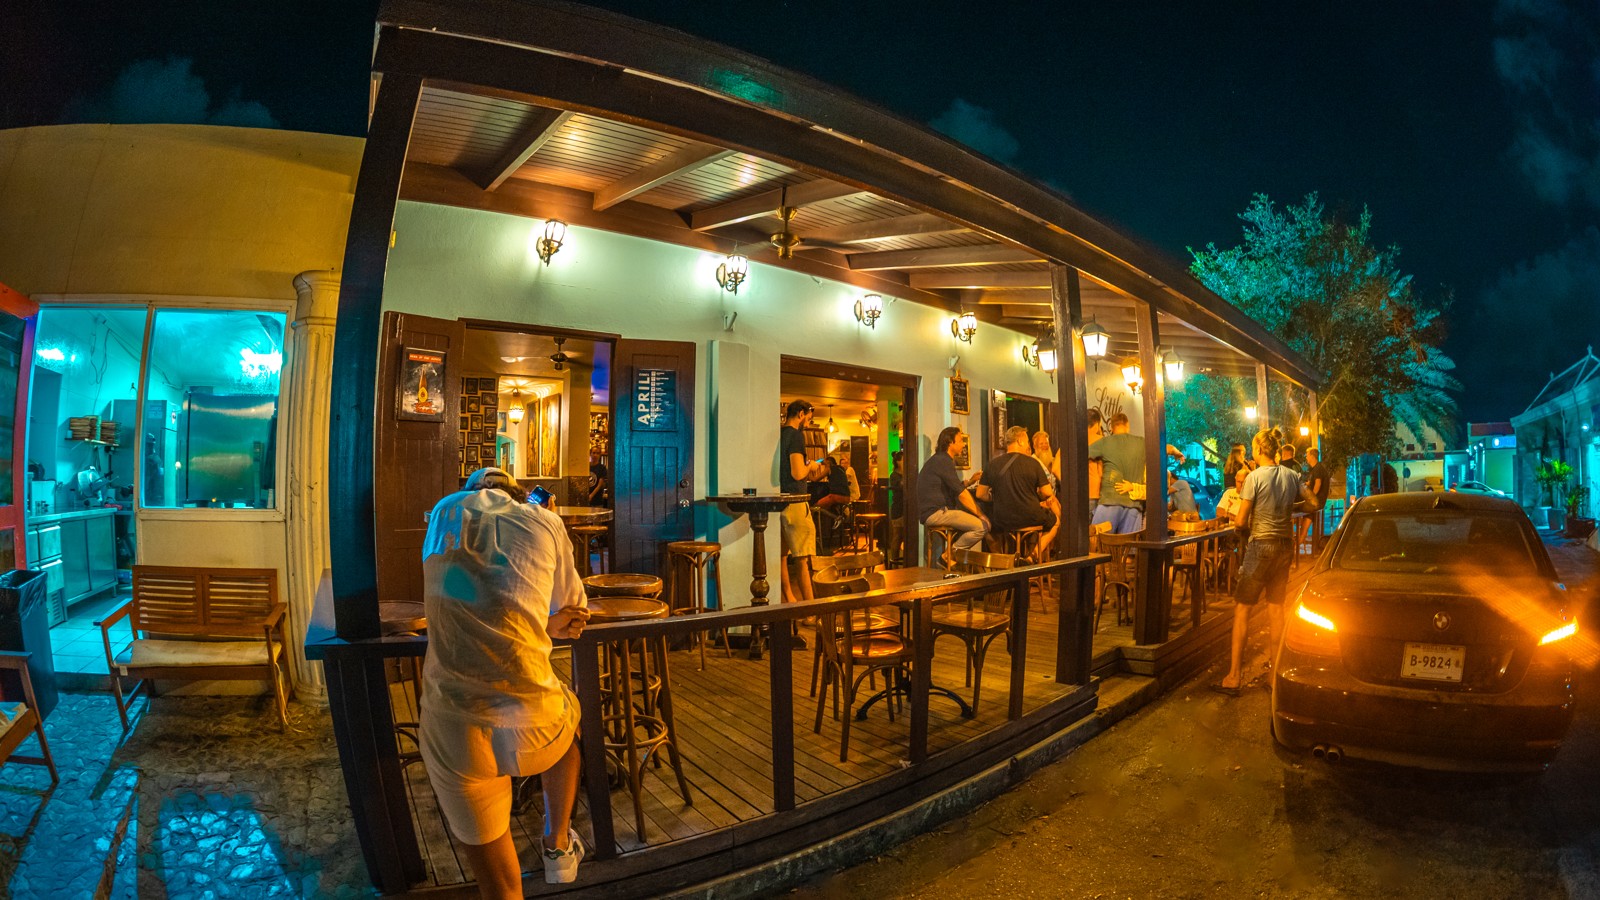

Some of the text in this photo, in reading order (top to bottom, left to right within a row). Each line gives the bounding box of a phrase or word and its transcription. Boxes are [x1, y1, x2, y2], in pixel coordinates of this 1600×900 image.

[638, 377, 650, 425] APRIL
[1093, 386, 1125, 417] Little
[1410, 654, 1451, 669] B-9824
